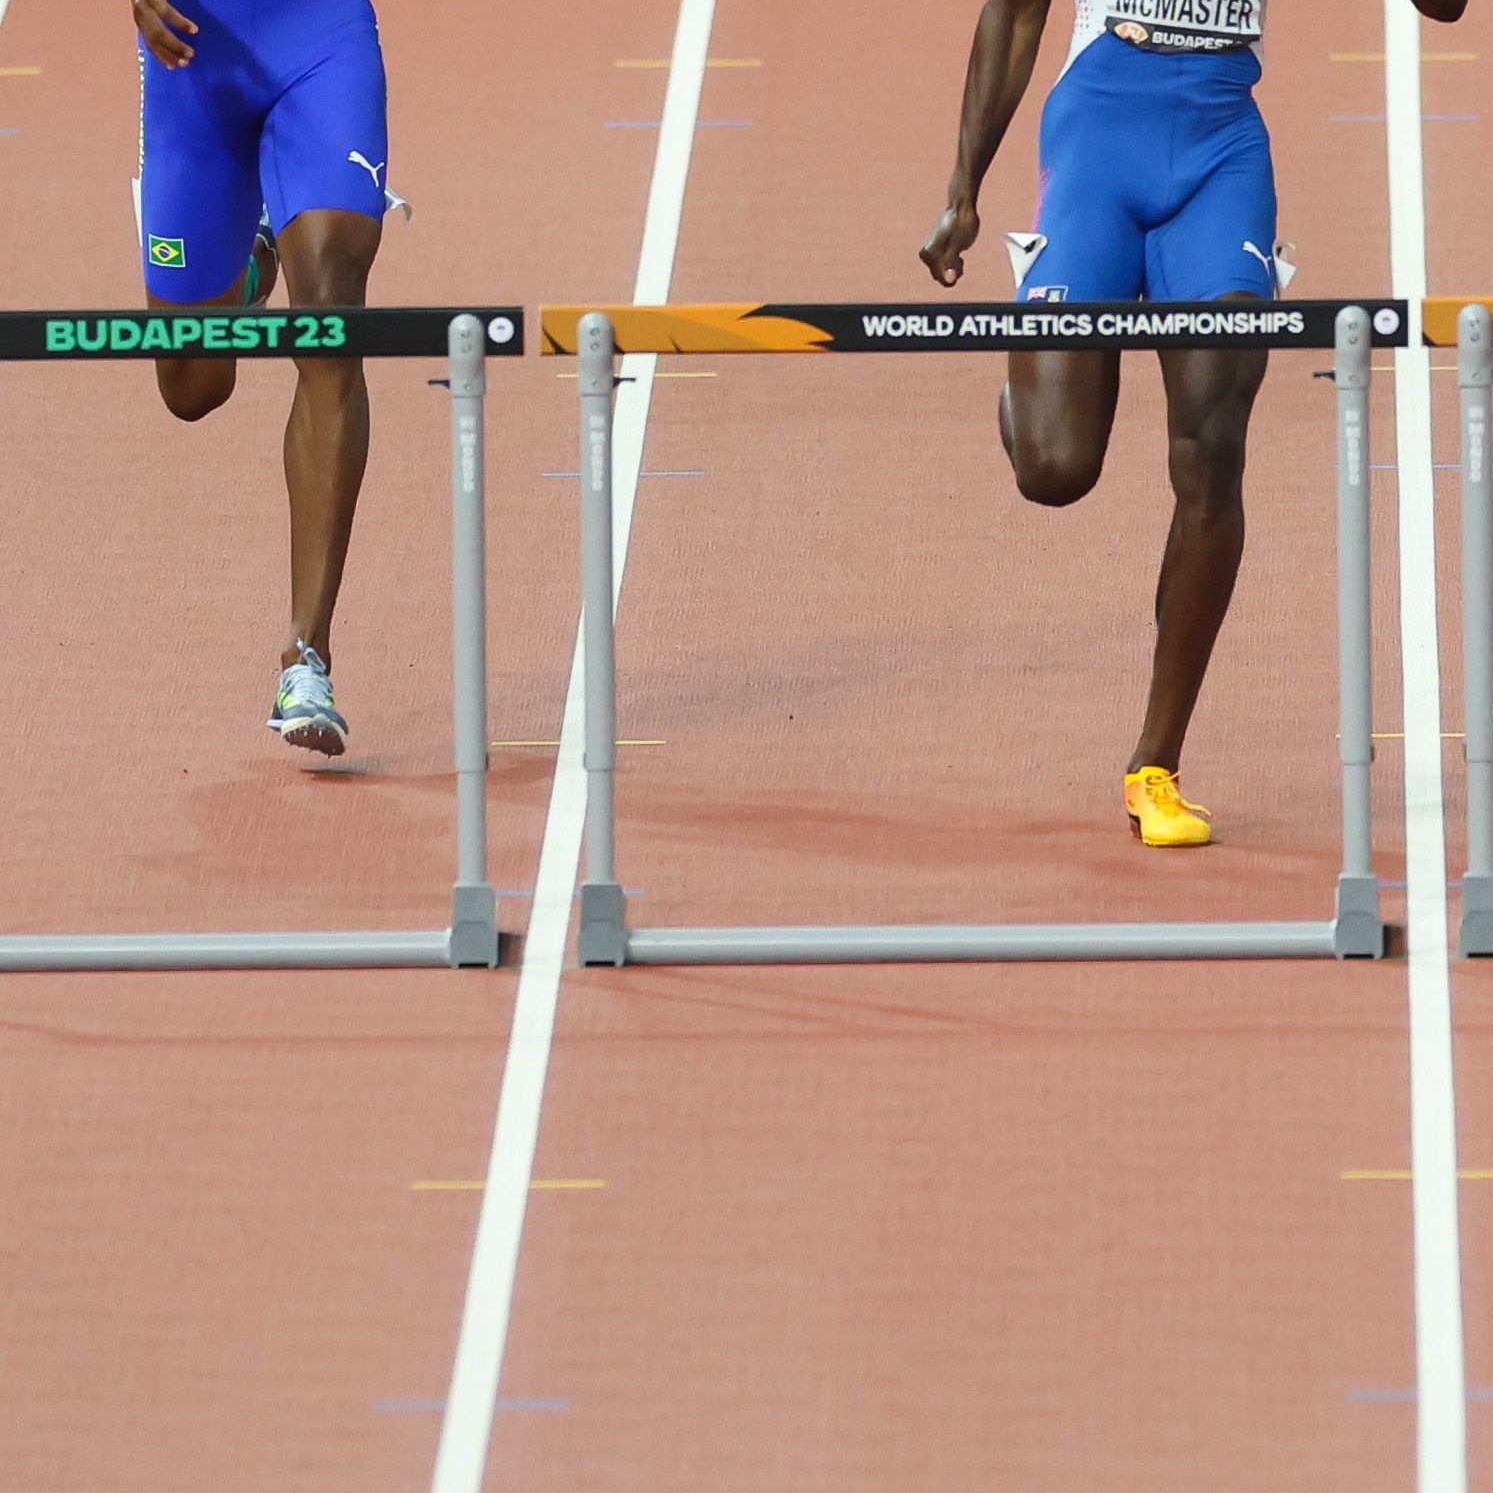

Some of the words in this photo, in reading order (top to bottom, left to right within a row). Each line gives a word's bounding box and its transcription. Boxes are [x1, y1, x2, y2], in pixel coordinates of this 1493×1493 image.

[45, 316, 287, 352] BUDAPEST
[294, 315, 347, 348] 23
[862, 314, 954, 339] WORLD
[959, 313, 1093, 337] ATHLETICS
[1097, 311, 1305, 336] CHAMPIONSHIPS
